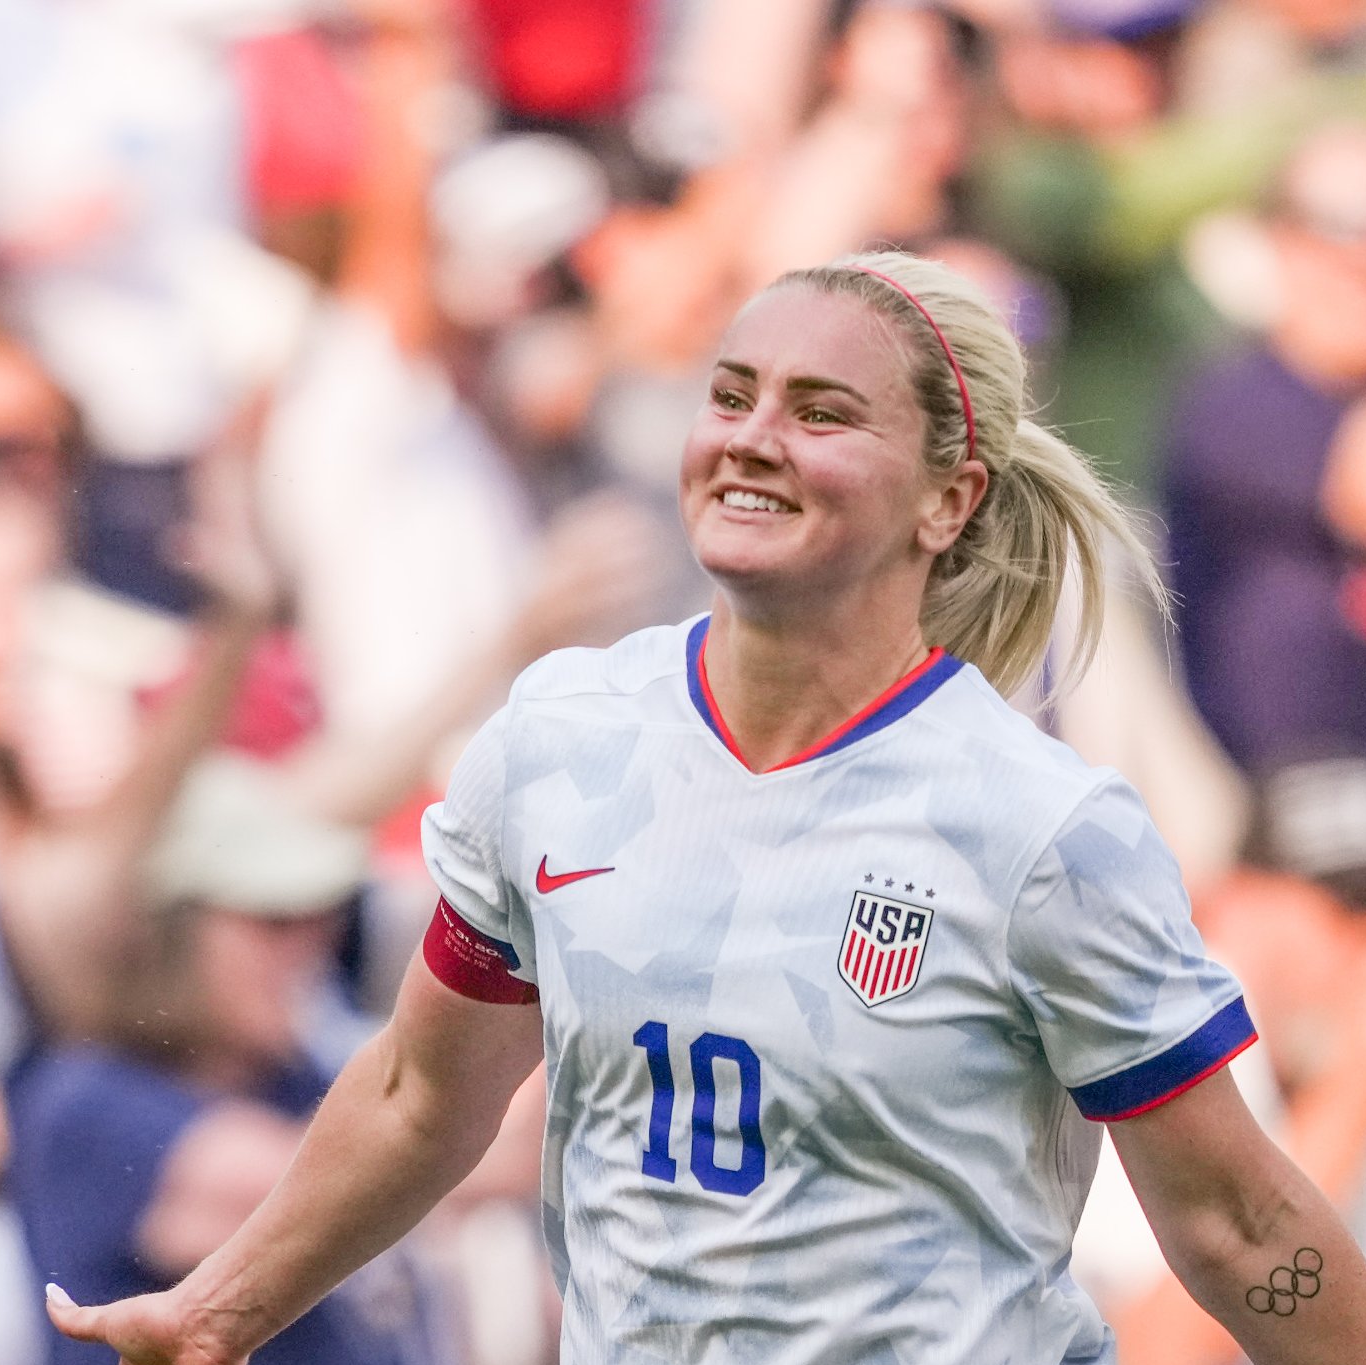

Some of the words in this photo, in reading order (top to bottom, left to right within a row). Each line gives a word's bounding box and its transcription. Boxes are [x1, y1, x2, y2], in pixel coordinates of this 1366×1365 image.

[856, 899, 926, 945] USA
[475, 943, 502, 958] 20
[633, 1020, 766, 1197] 10
